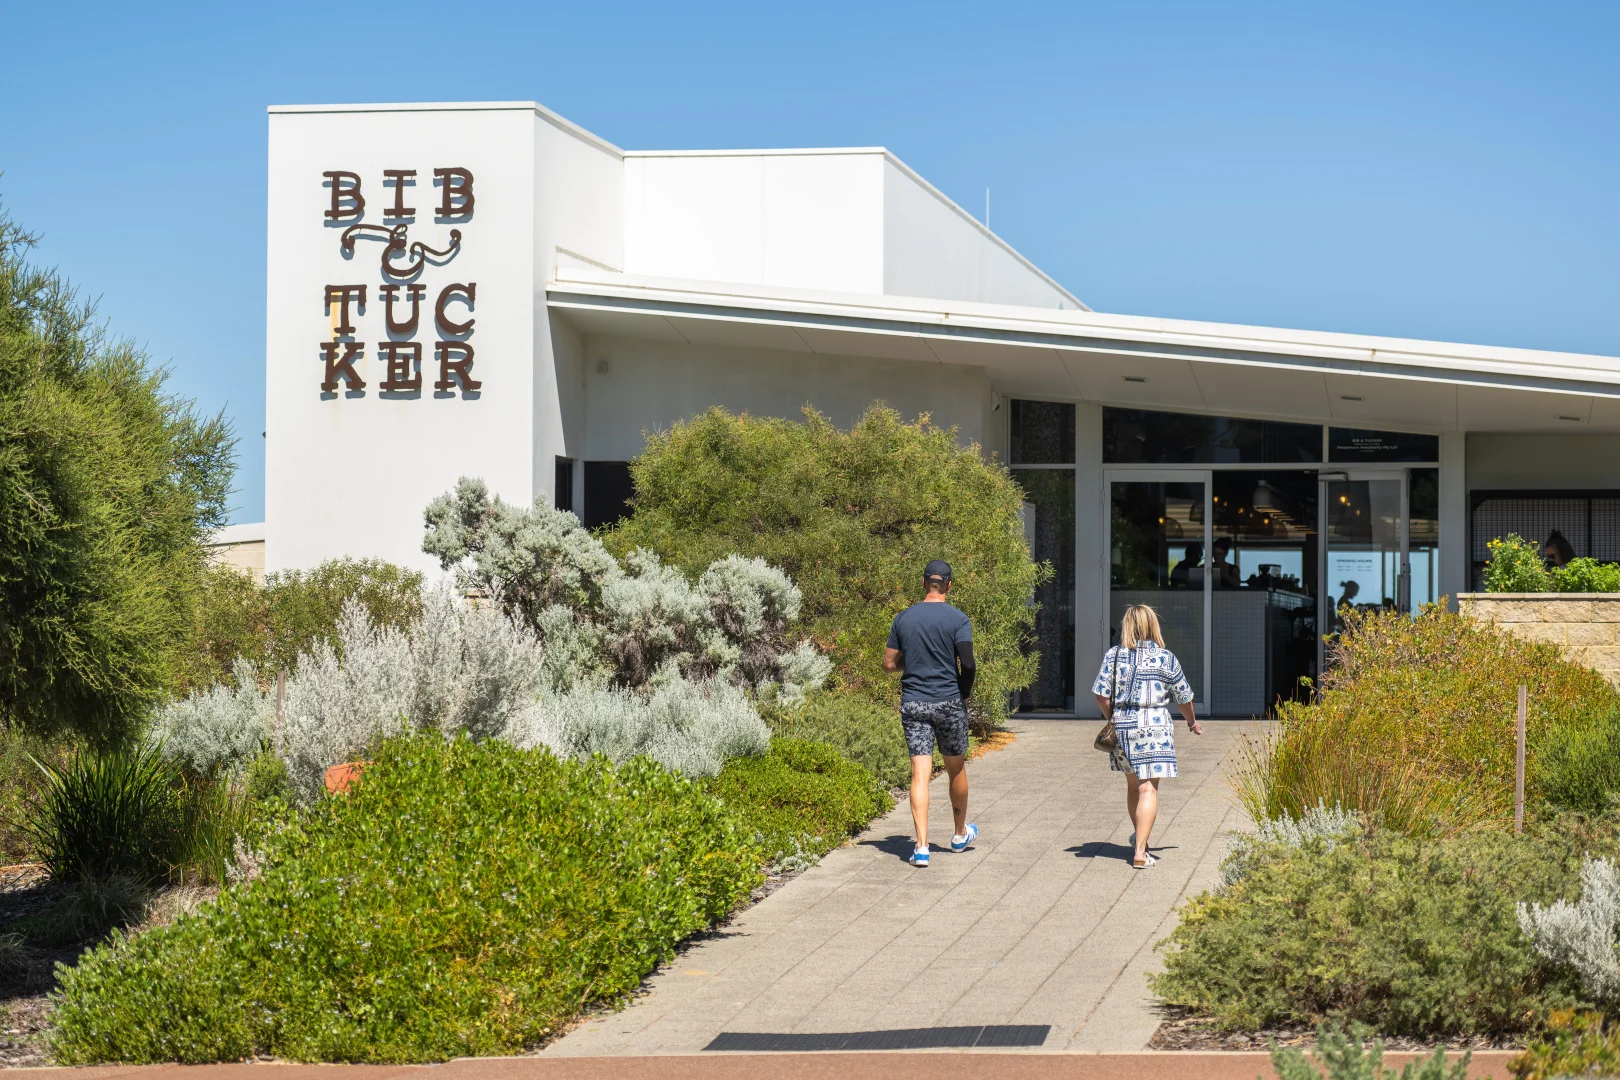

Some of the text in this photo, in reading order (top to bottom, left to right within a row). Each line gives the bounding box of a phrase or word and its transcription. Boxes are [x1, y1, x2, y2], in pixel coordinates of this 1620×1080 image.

[323, 167, 475, 220] BIB
[341, 223, 461, 277] &
[325, 283, 476, 335] TUC
[320, 341, 482, 392] KER
